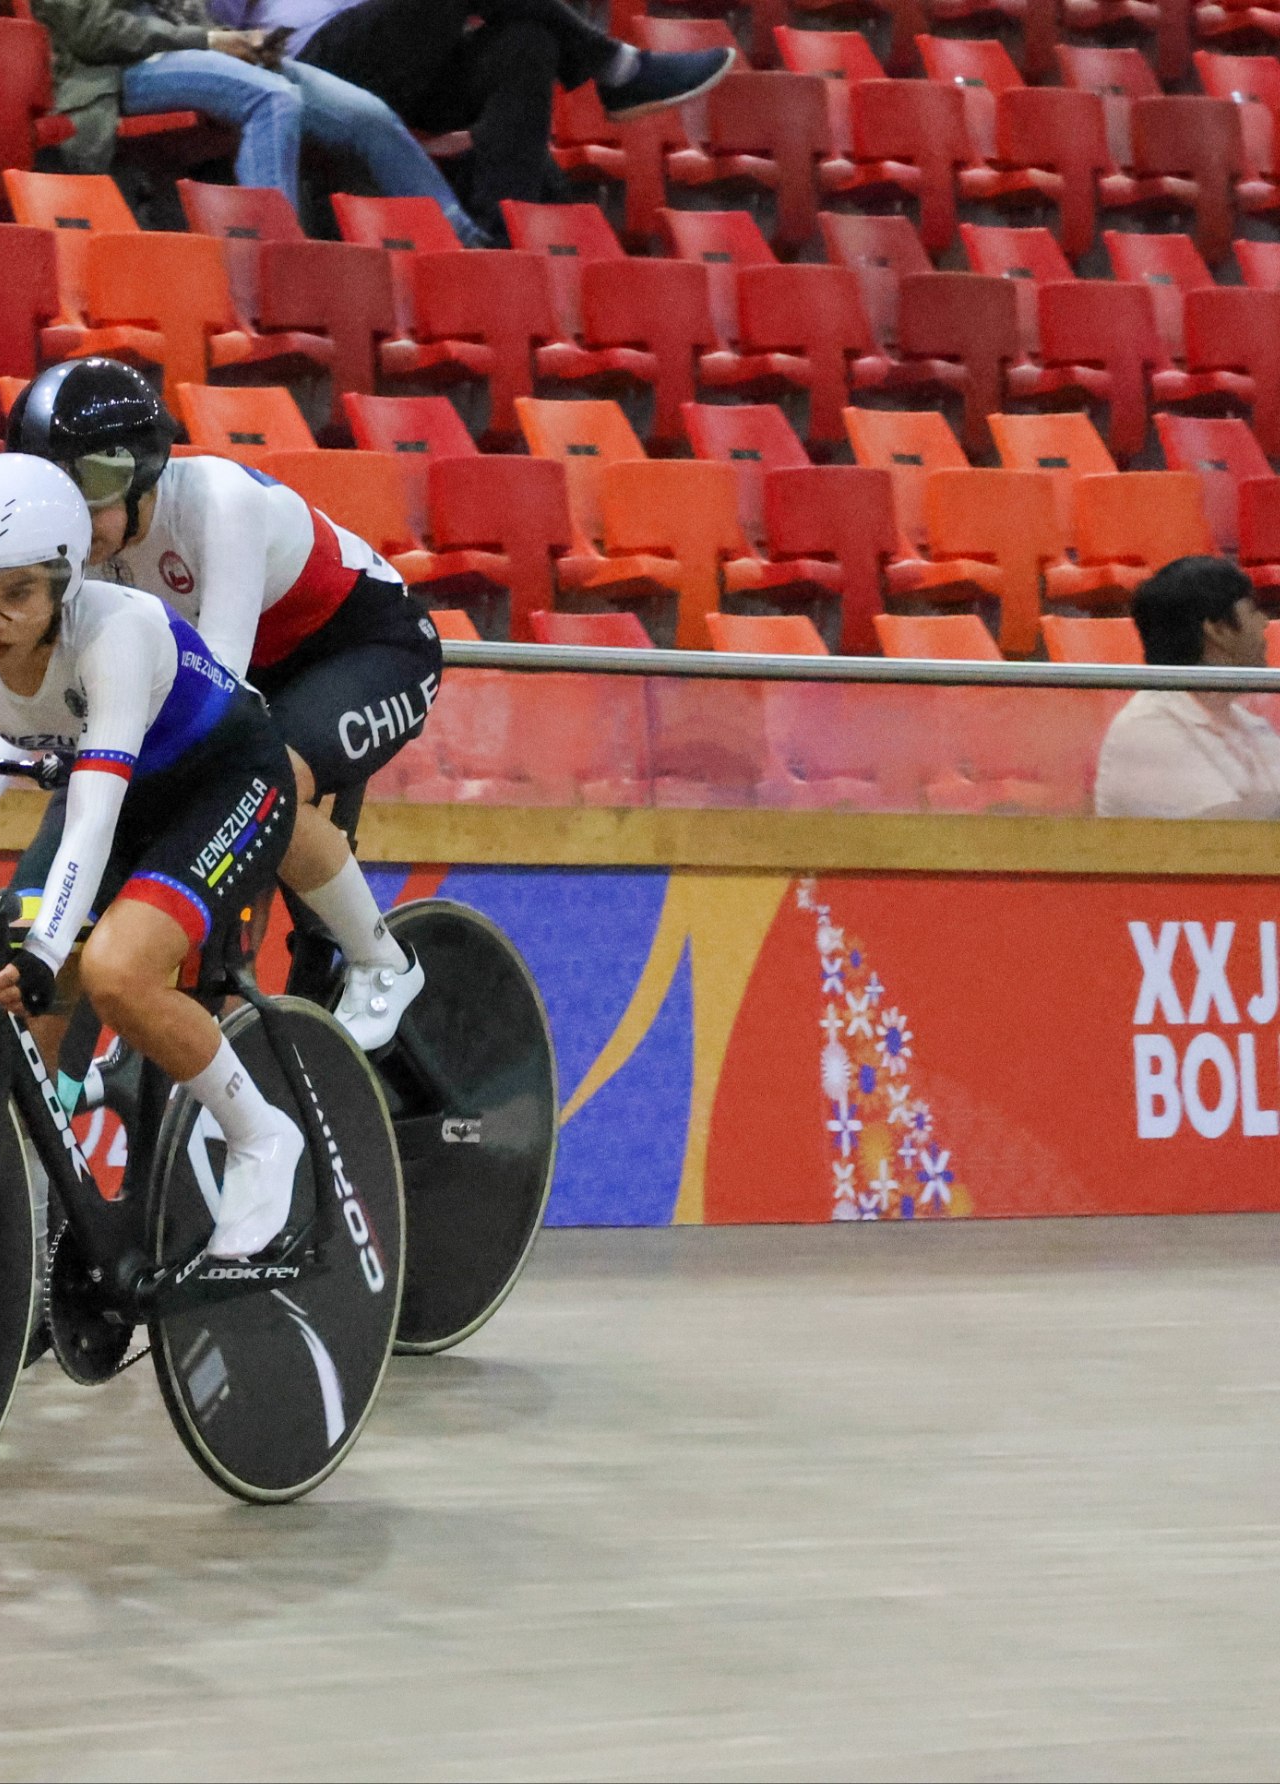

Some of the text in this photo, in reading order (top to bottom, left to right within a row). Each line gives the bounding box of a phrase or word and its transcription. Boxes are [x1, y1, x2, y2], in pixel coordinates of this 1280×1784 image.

[338, 673, 439, 760] CHILE
[189, 777, 269, 879] VENEZUELA
[44, 861, 79, 939] VENEZUELA
[1128, 920, 1240, 1025] XX
[265, 1266, 300, 1279] P24
